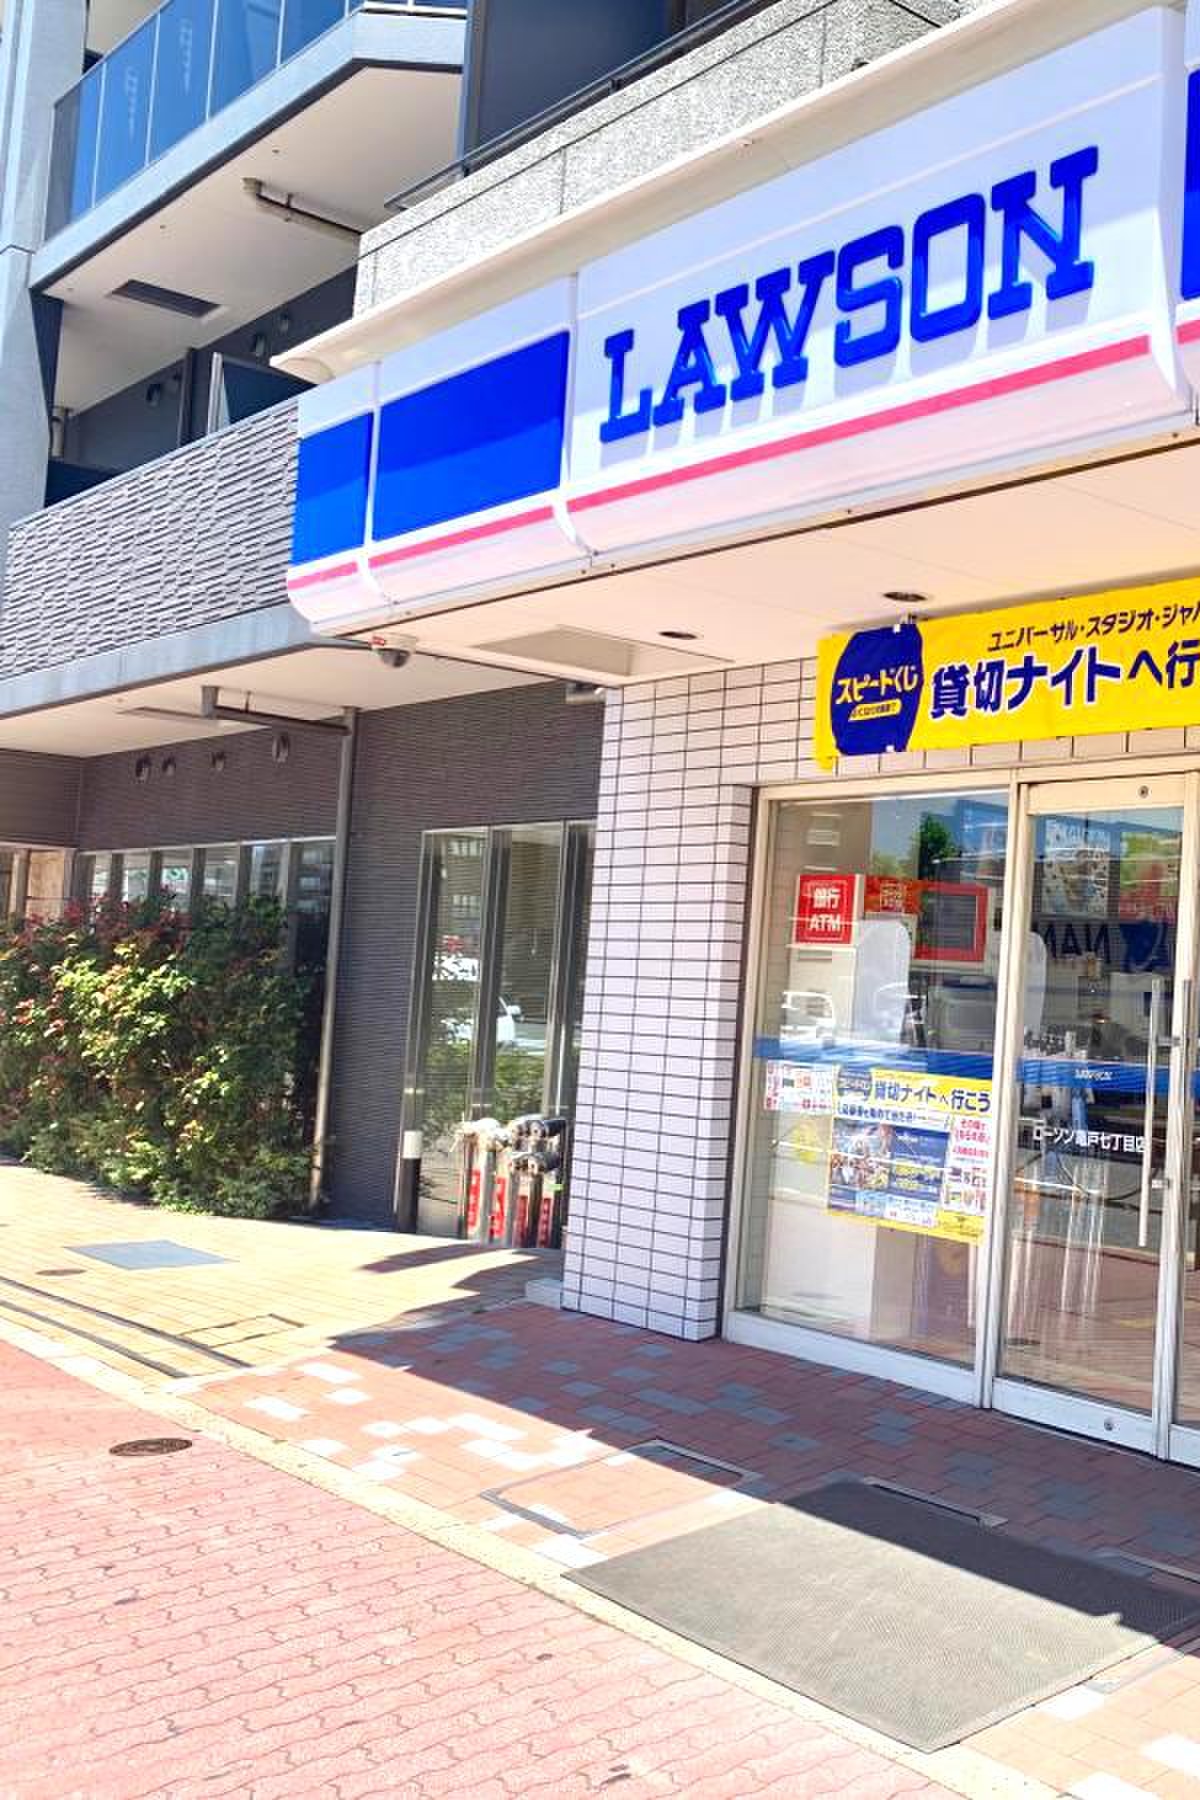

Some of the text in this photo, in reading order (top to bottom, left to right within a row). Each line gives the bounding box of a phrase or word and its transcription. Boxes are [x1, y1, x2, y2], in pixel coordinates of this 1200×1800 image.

[600, 146, 1099, 443] LAWSON
[835, 665, 918, 704] スピードくじ
[809, 914, 842, 932] ATM
